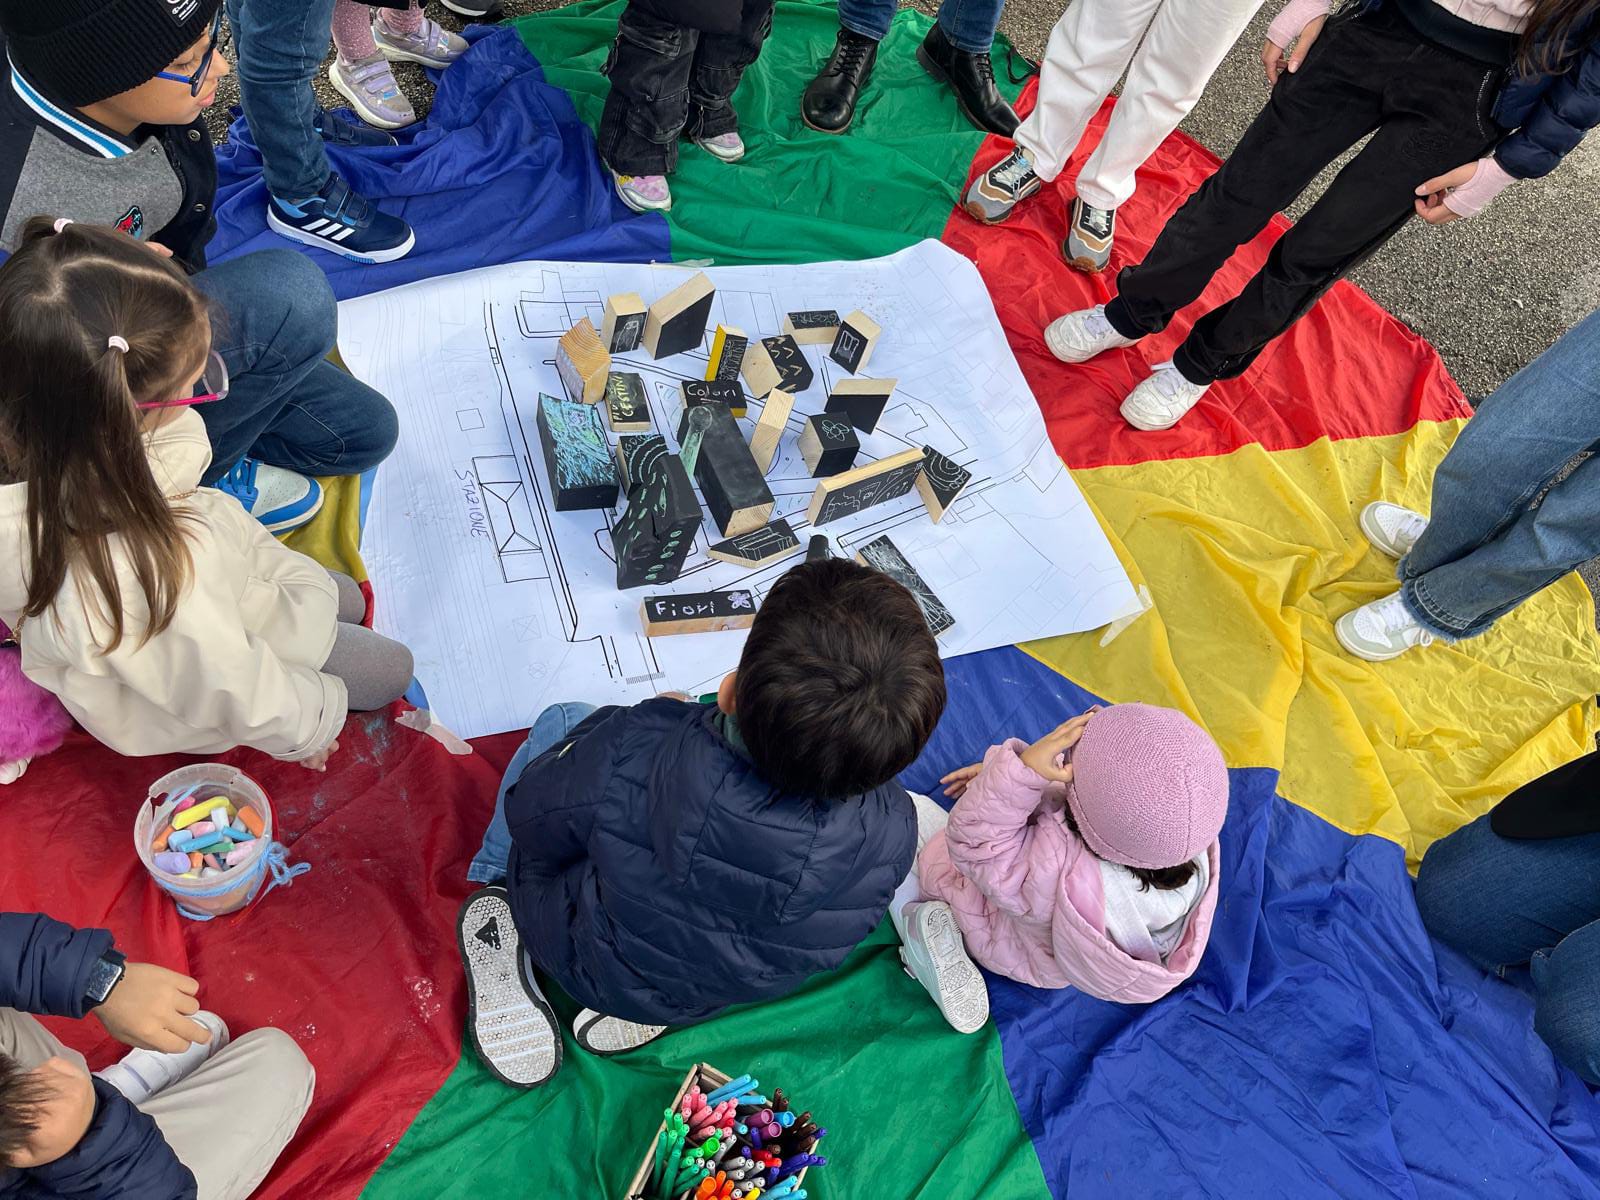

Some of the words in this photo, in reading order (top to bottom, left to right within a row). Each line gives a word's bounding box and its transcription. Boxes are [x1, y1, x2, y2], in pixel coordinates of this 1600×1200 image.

[687, 383, 736, 397] Colori
[455, 469, 491, 542] STAZIONE
[655, 601, 715, 616] Fiori
